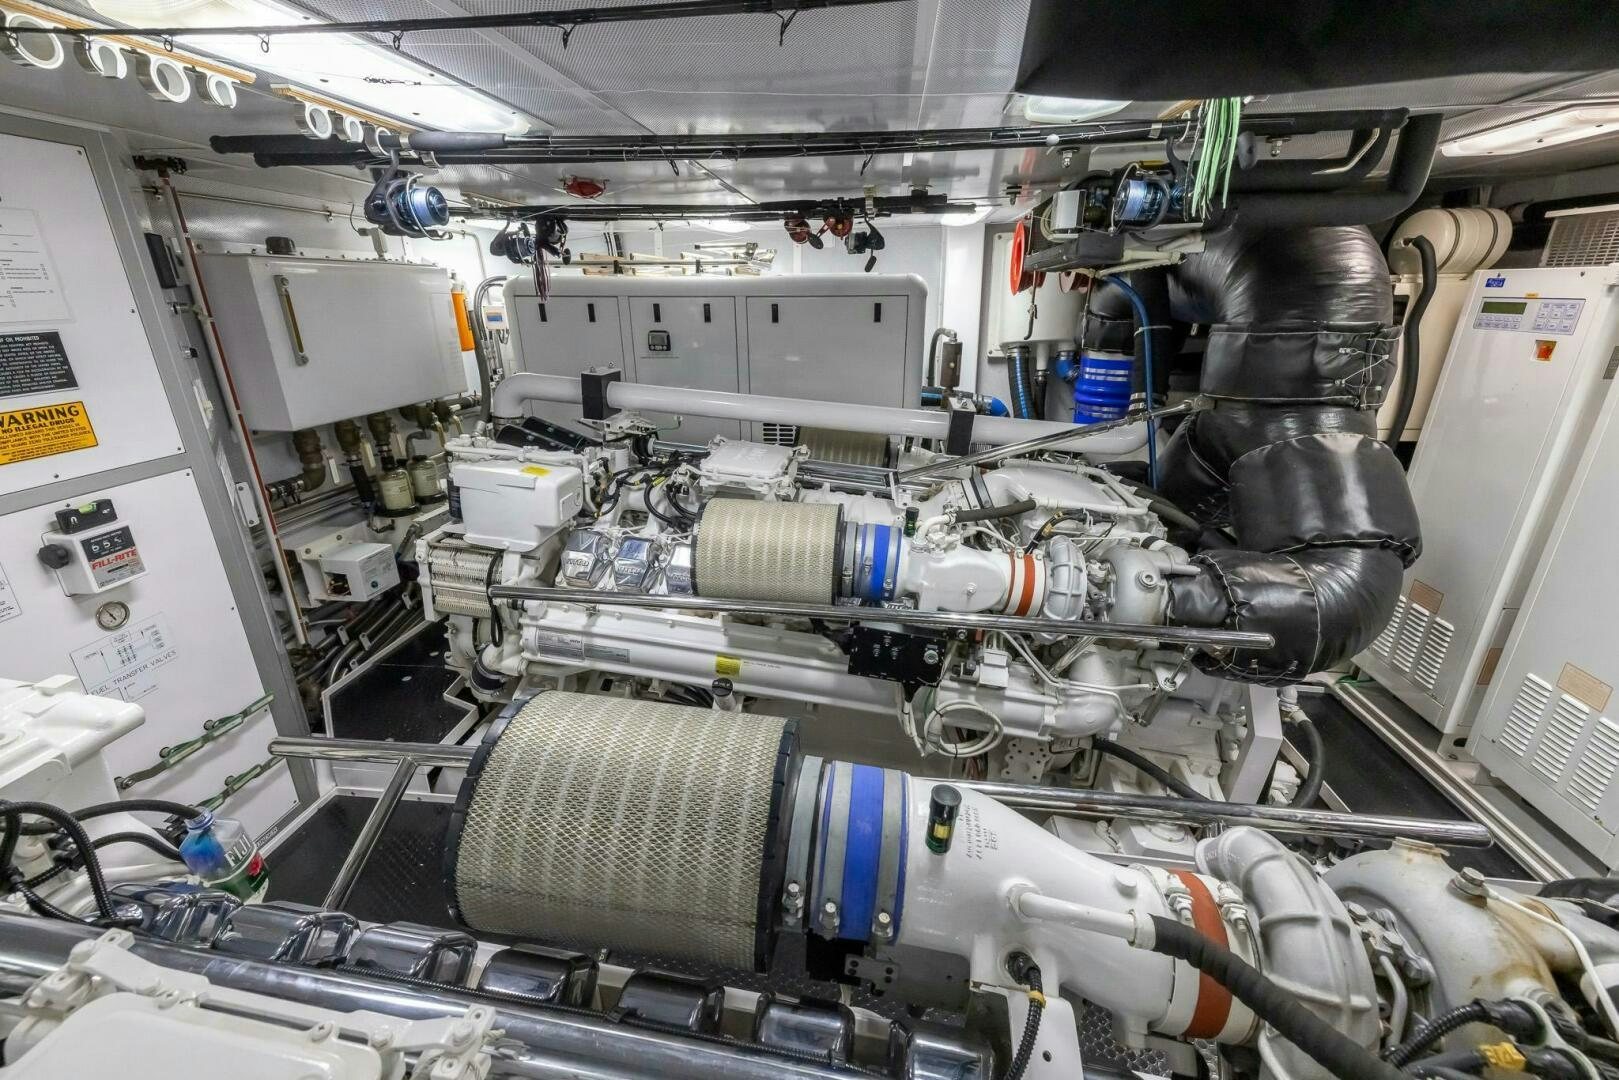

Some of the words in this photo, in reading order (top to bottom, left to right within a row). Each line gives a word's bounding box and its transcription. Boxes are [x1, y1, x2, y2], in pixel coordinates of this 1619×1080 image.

[15, 422, 49, 432] ILLEGAL
[49, 418, 75, 426] DRUGS
[92, 549, 137, 570] FILL-RITE
[113, 664, 149, 685] TRANSFER
[150, 650, 177, 666] VALVES
[224, 834, 251, 867] FIJI
